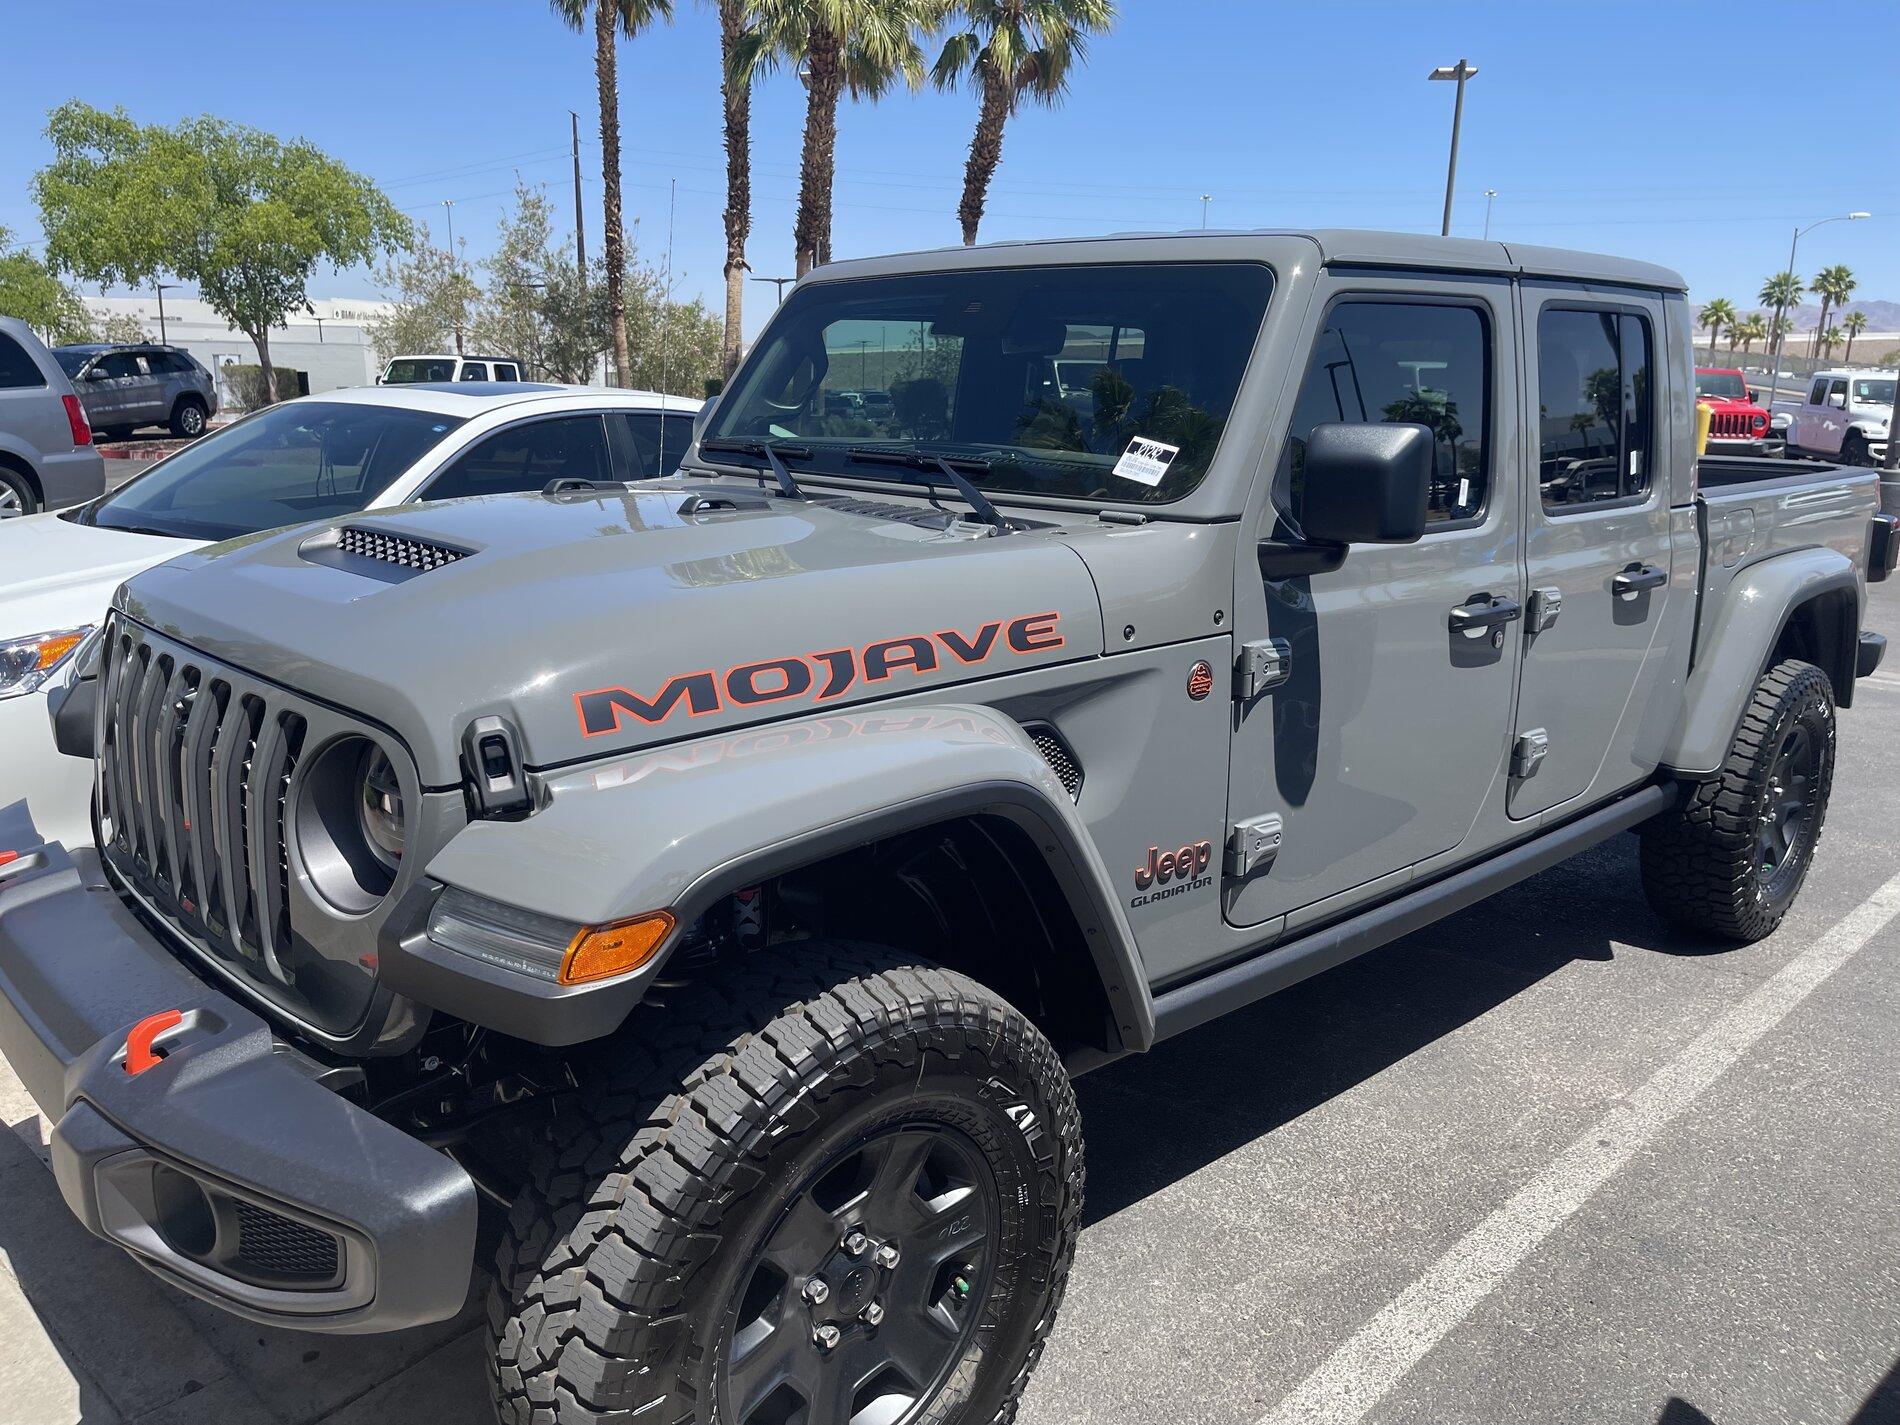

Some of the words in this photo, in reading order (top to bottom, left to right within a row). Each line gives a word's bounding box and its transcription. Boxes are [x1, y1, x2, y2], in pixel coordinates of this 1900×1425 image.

[573, 611, 1064, 738] MOJAVE
[1135, 841, 1212, 891] Jeep
[1131, 876, 1212, 908] GLADIATOR
